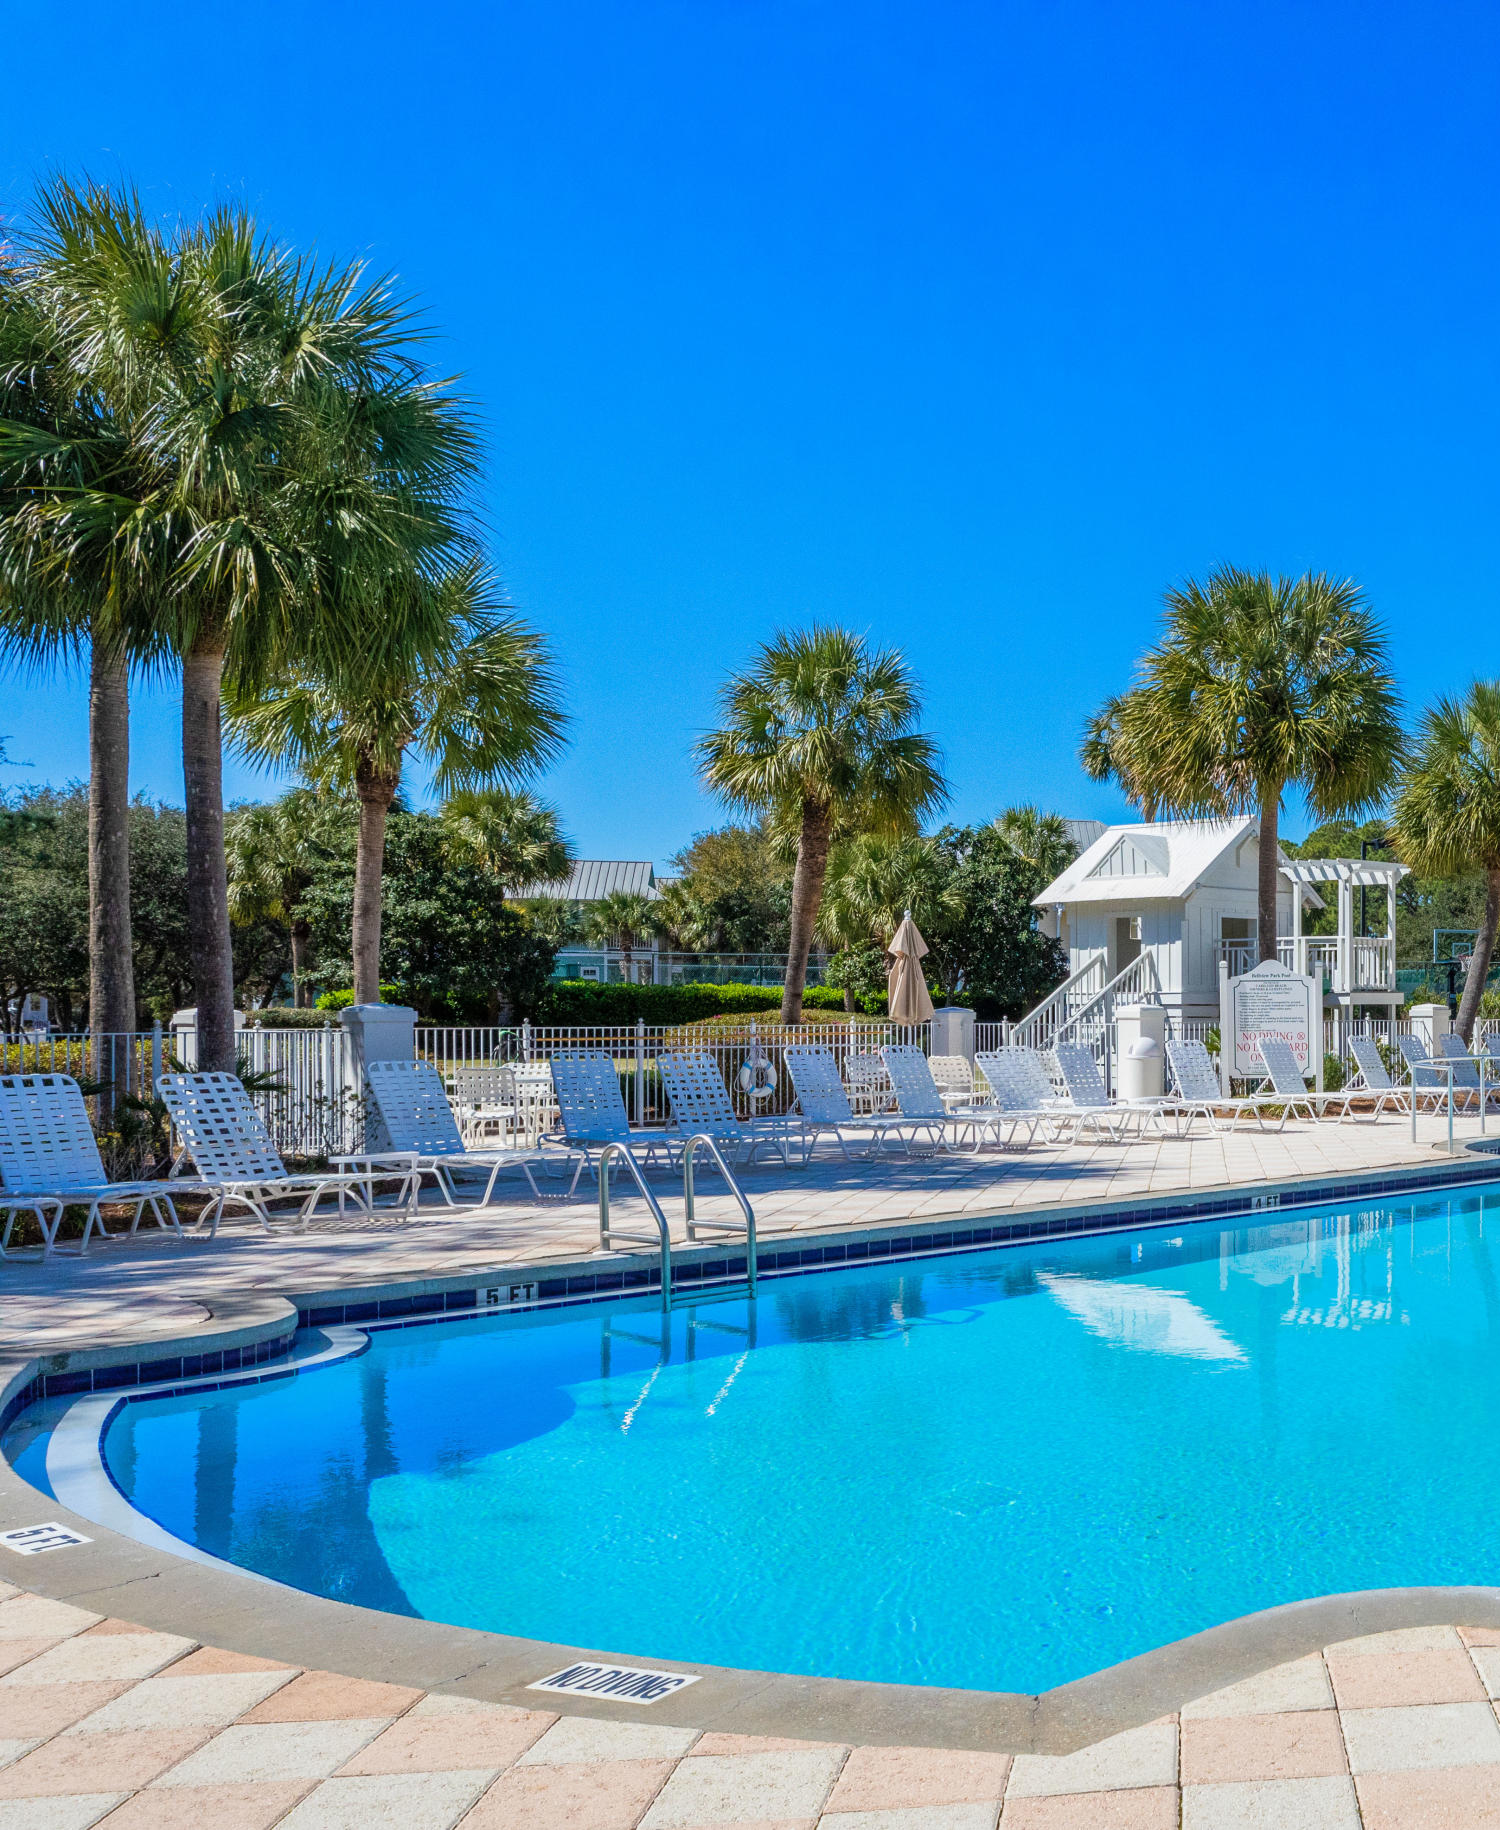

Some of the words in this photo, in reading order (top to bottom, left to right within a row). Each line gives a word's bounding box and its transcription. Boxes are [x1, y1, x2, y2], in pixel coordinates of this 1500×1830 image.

[1242, 1032, 1257, 1041] NO
[1259, 1032, 1293, 1041] DIVING
[1237, 1043, 1251, 1052] NO
[1267, 1195, 1278, 1207] FT
[486, 1288, 499, 1304] 5
[510, 1283, 534, 1301] FT
[6, 1527, 58, 1539] 5
[540, 1666, 602, 1688] NO
[574, 1670, 686, 1699] DIVING
